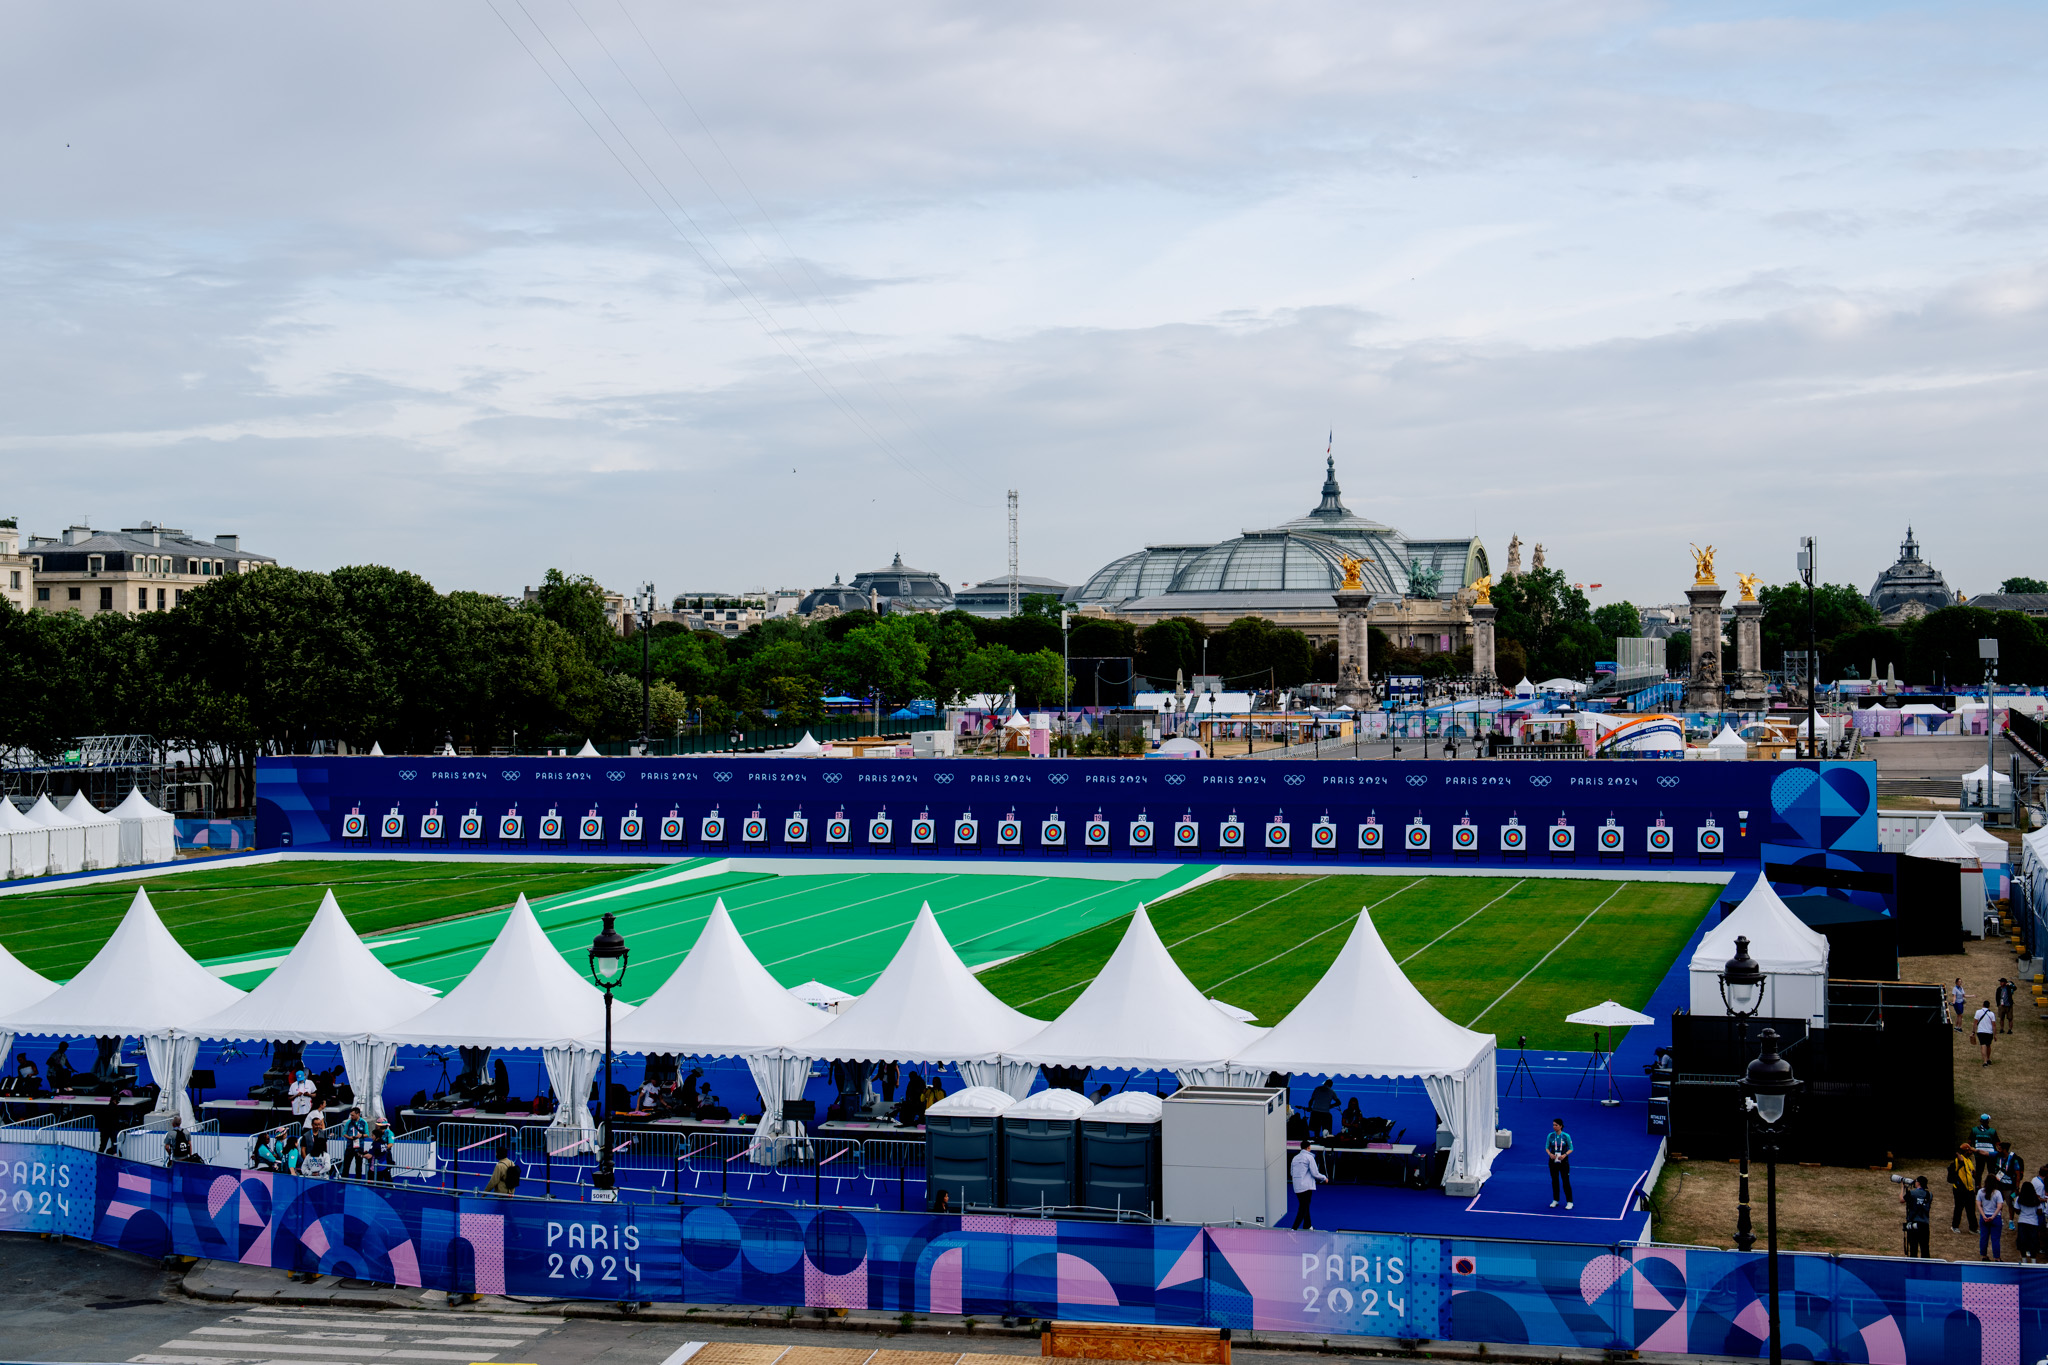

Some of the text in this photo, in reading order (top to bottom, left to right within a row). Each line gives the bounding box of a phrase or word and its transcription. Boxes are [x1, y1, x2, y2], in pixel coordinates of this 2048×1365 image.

[462, 772, 486, 780] 2024
[566, 772, 592, 780] 2024
[672, 772, 698, 780] 2024
[781, 774, 806, 782] 2024
[892, 774, 918, 782] 2024
[1004, 774, 1032, 782] 2024
[1120, 776, 1148, 784] 2024
[1238, 776, 1266, 784] 2024
[1358, 776, 1388, 784] 2024
[1482, 776, 1510, 784] 2024
[1608, 778, 1638, 786] 2024
[548, 1253, 641, 1282] 2024
[1302, 1286, 1405, 1318] 2024
